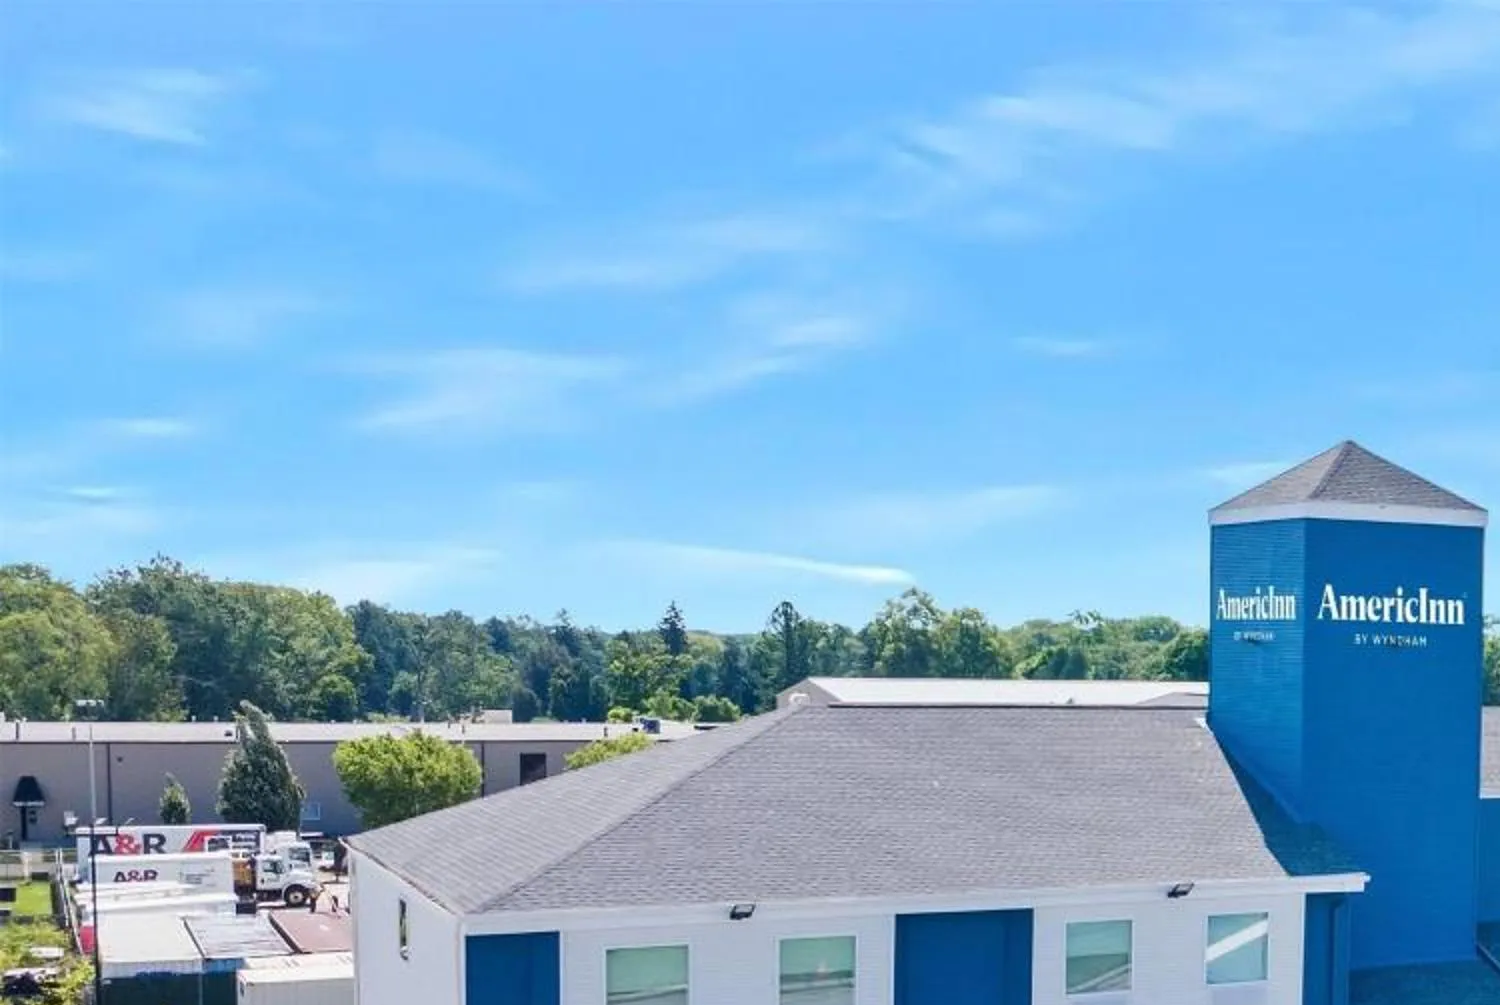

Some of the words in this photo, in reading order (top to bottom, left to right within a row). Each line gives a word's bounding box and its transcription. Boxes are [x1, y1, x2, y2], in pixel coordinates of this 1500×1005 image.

[1216, 586, 1297, 620] AmericInn
[1317, 583, 1466, 625] AmericInn
[1354, 633, 1369, 645] BY
[1372, 634, 1428, 647] WYNDHAM
[88, 833, 167, 855] A&R
